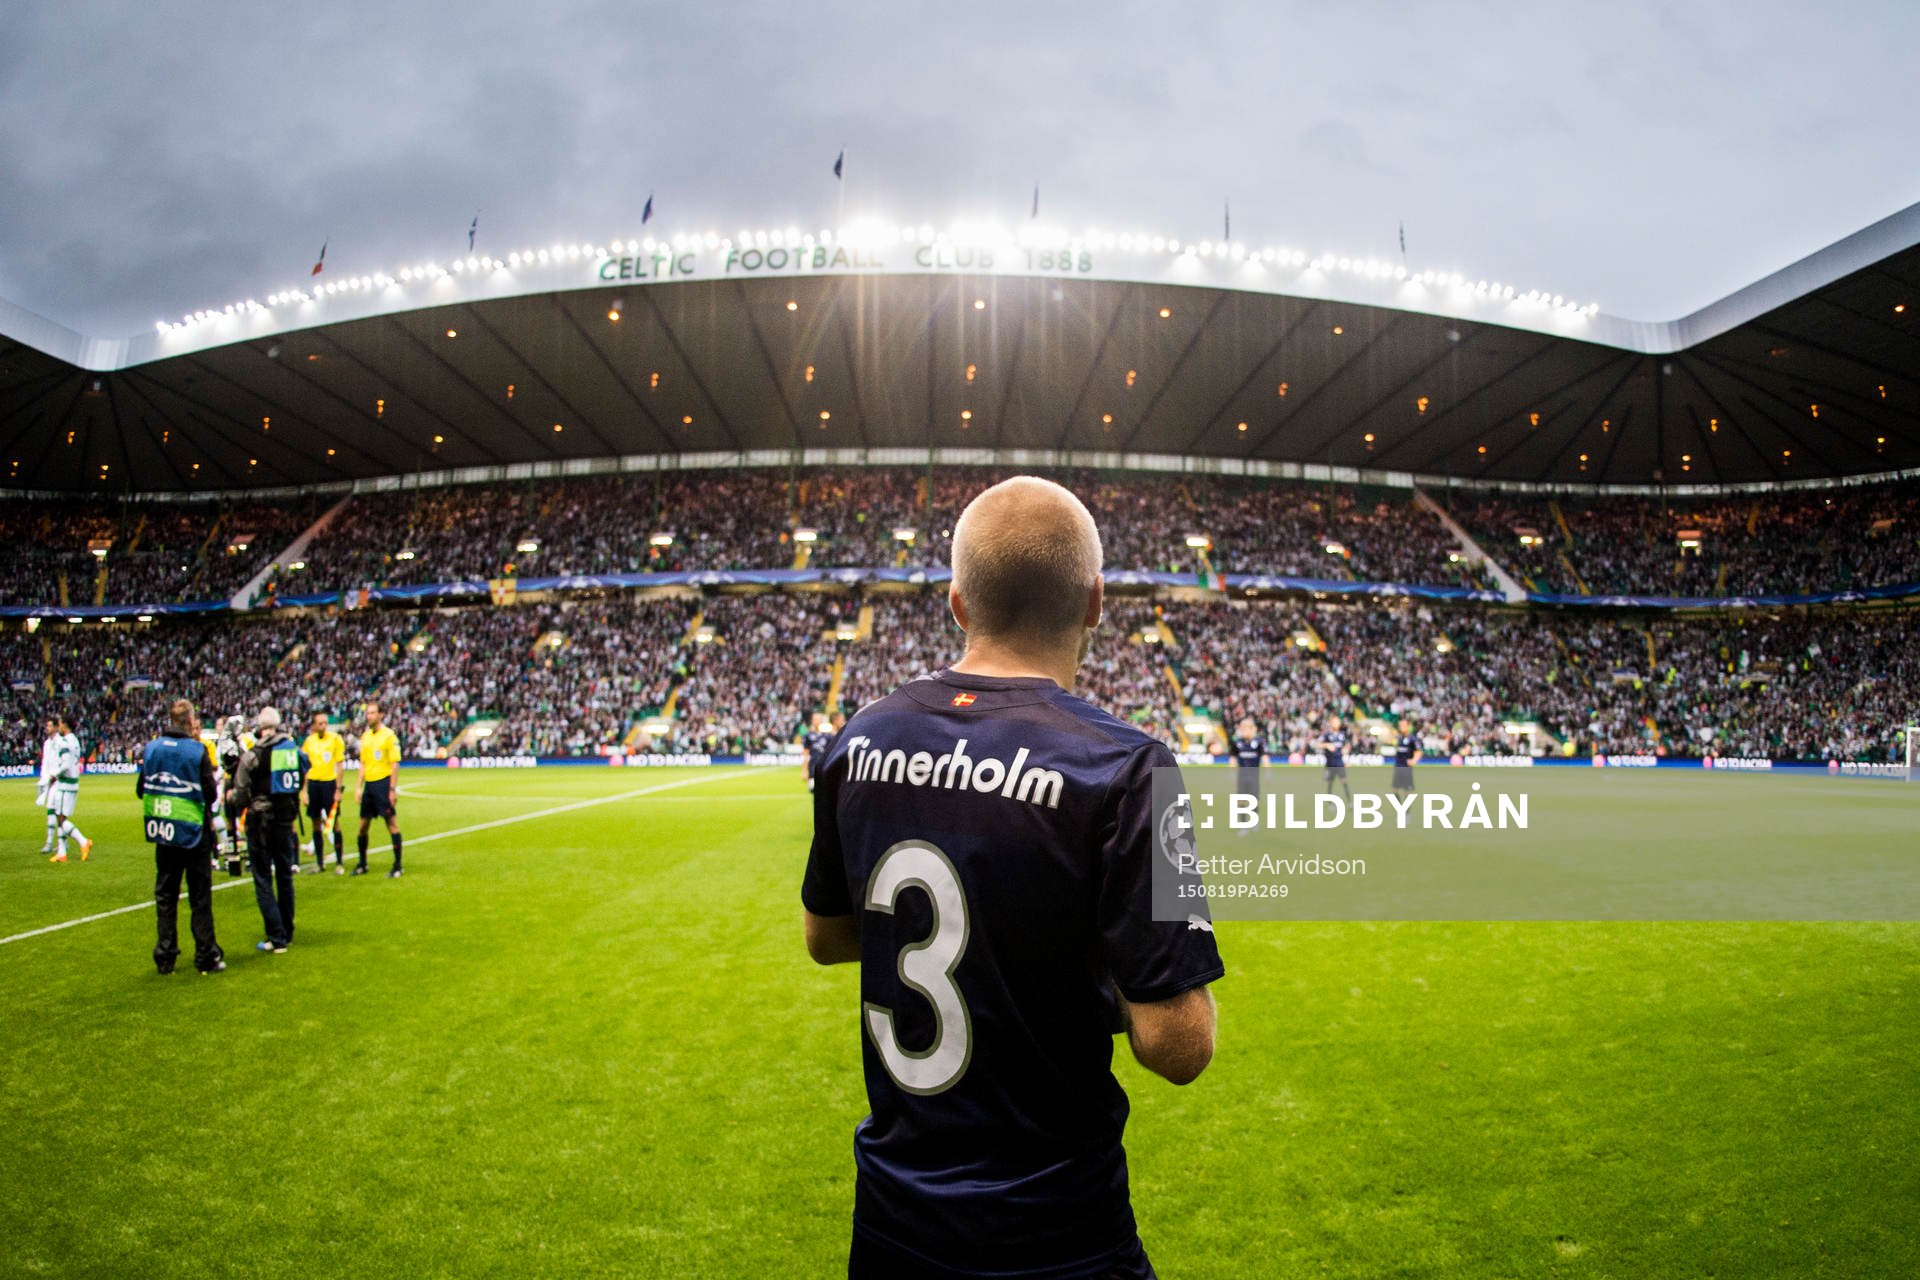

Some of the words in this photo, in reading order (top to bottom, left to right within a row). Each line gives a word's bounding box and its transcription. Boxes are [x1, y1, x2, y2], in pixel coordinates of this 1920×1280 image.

[599, 253, 695, 280] CELTIC
[725, 247, 882, 272] FOOTBALL
[915, 246, 994, 268] CLUB
[1023, 249, 1092, 272] 1888
[847, 736, 1063, 809] Tinnerholm
[1841, 762, 1857, 776] NO
[1857, 762, 1872, 776] TO
[154, 799, 172, 816] HB
[147, 819, 175, 841] 040
[864, 839, 973, 1096] 3
